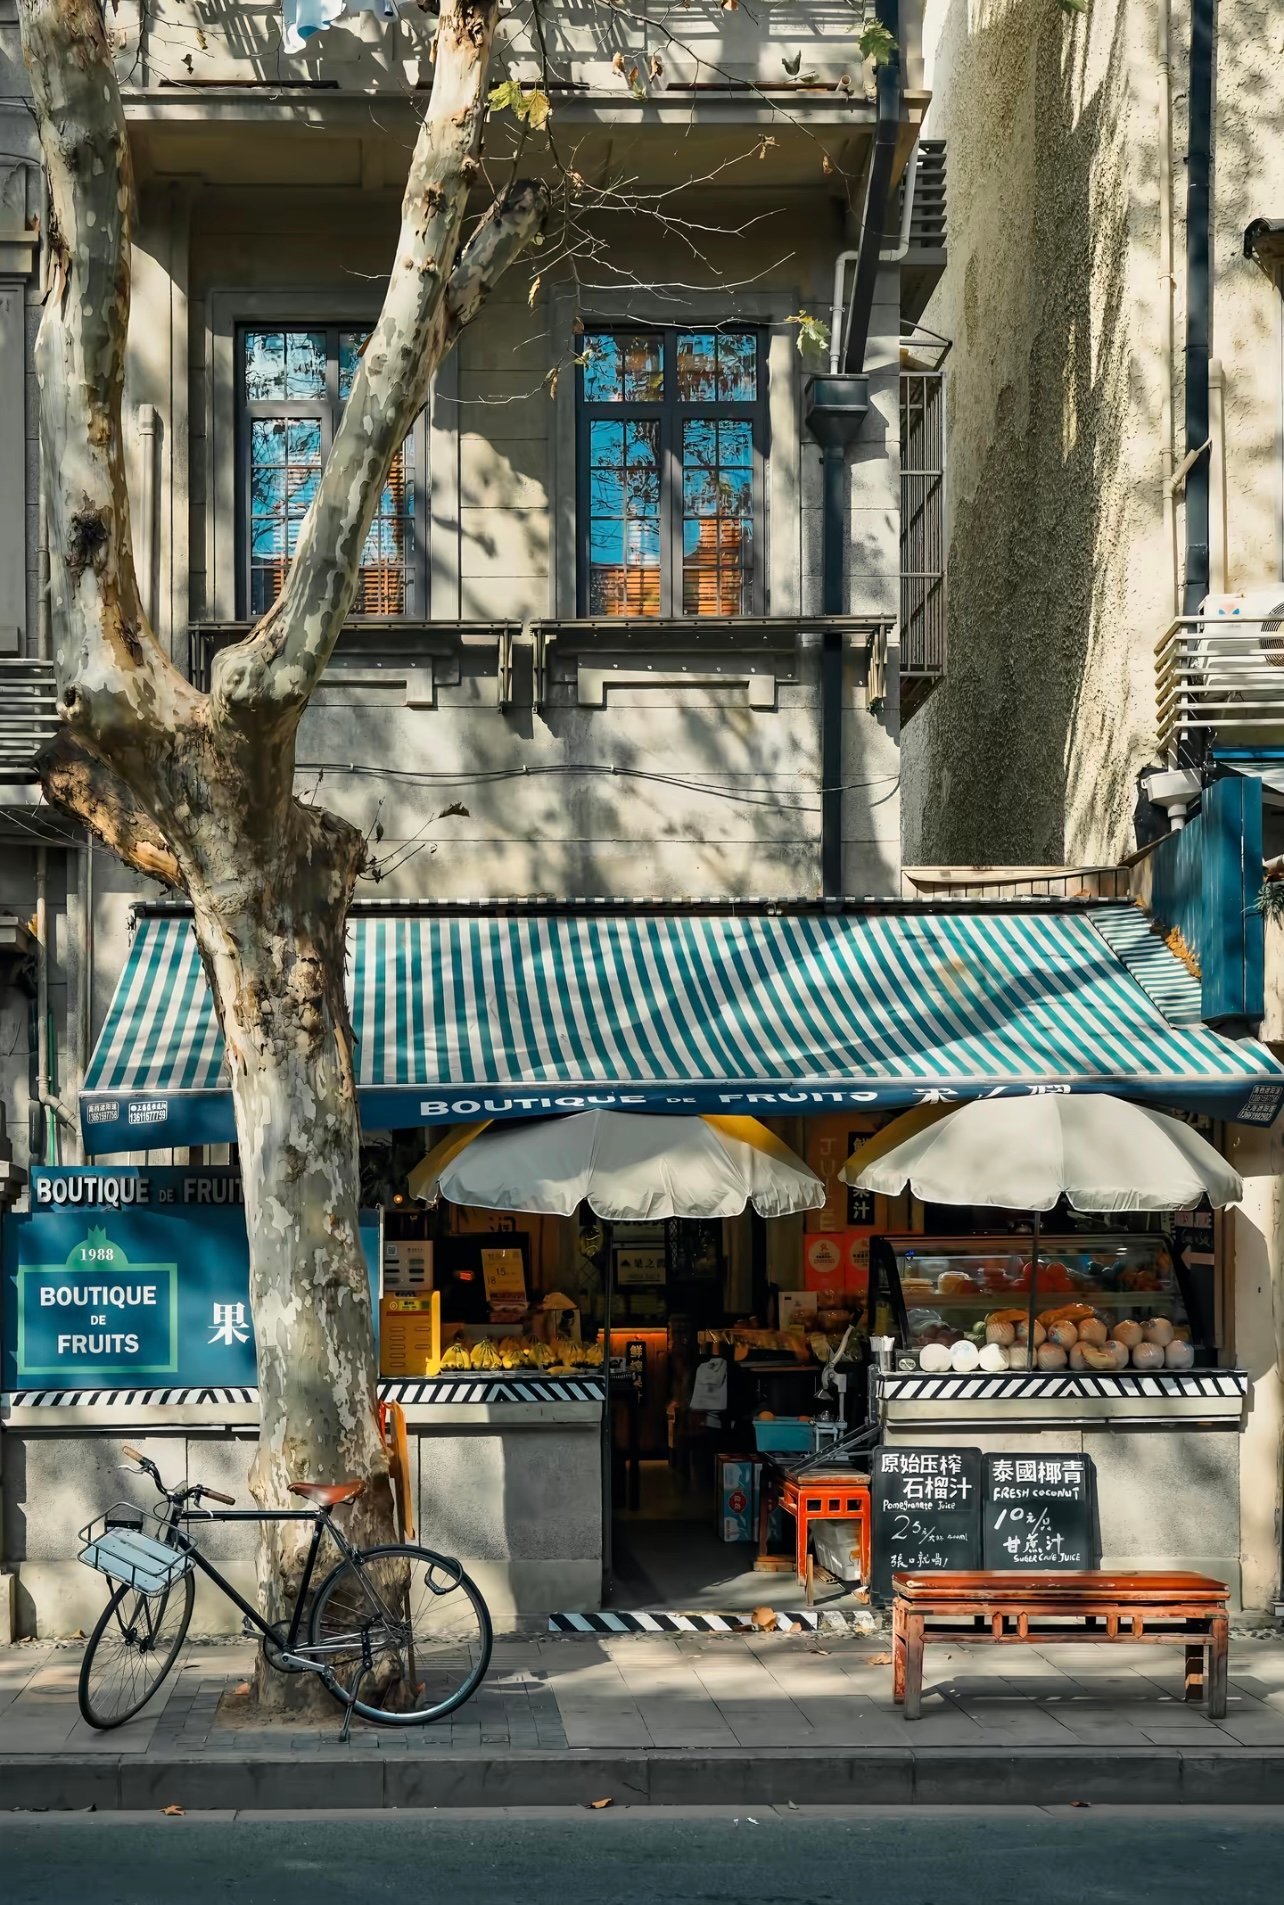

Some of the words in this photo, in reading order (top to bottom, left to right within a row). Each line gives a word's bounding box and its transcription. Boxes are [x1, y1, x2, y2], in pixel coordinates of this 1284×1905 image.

[420, 1095, 647, 1116] BOUTIQUE
[718, 1091, 879, 1103] FRUITS
[36, 1176, 150, 1207] BOUTIQUE
[159, 1188, 175, 1203] DE
[79, 1248, 115, 1261] 1988
[40, 1285, 157, 1309] BOUTIQUE
[90, 1314, 107, 1326] DE
[207, 1301, 250, 1346] 果
[57, 1334, 140, 1355] FRUITS
[881, 1453, 963, 1475] 原始压榨
[992, 1459, 1085, 1484] 泰國椰青
[902, 1475, 973, 1500] 石榴汁
[993, 1486, 1030, 1502] FRESH
[883, 1499, 934, 1512] Pomegranate
[937, 1500, 956, 1511] Juice
[1003, 1533, 1065, 1555] 甘蔗汁
[1058, 1553, 1081, 1563] JUICE
